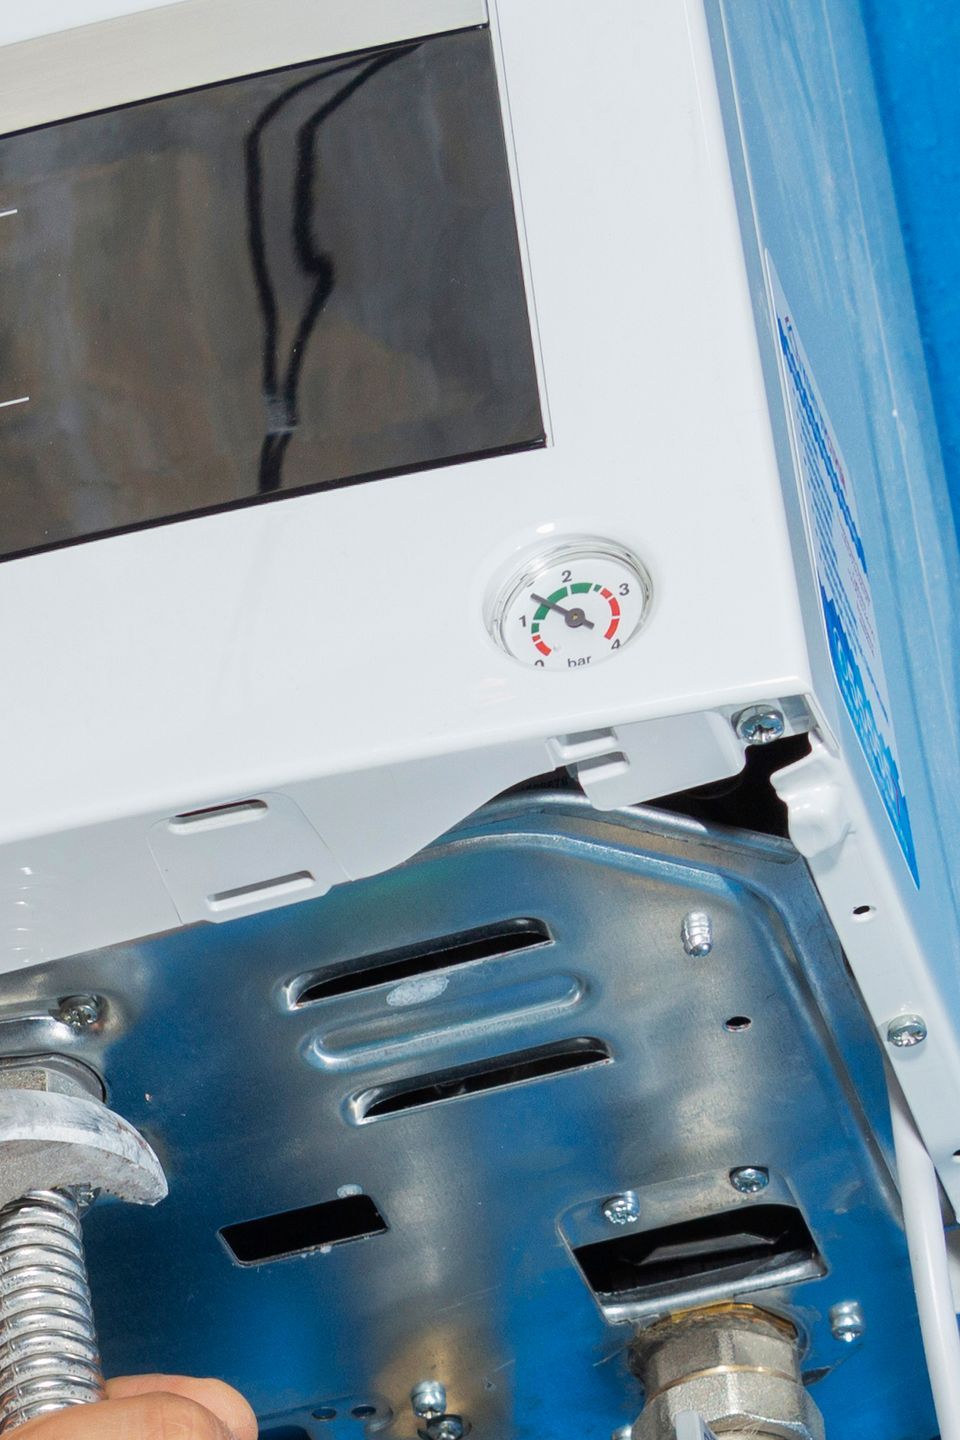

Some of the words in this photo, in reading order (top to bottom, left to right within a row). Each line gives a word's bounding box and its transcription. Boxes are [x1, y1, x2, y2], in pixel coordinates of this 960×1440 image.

[561, 570, 572, 583] 2
[618, 583, 630, 596] 3
[518, 615, 527, 628] 1
[610, 639, 621, 650] 4
[567, 656, 592, 668] bar
